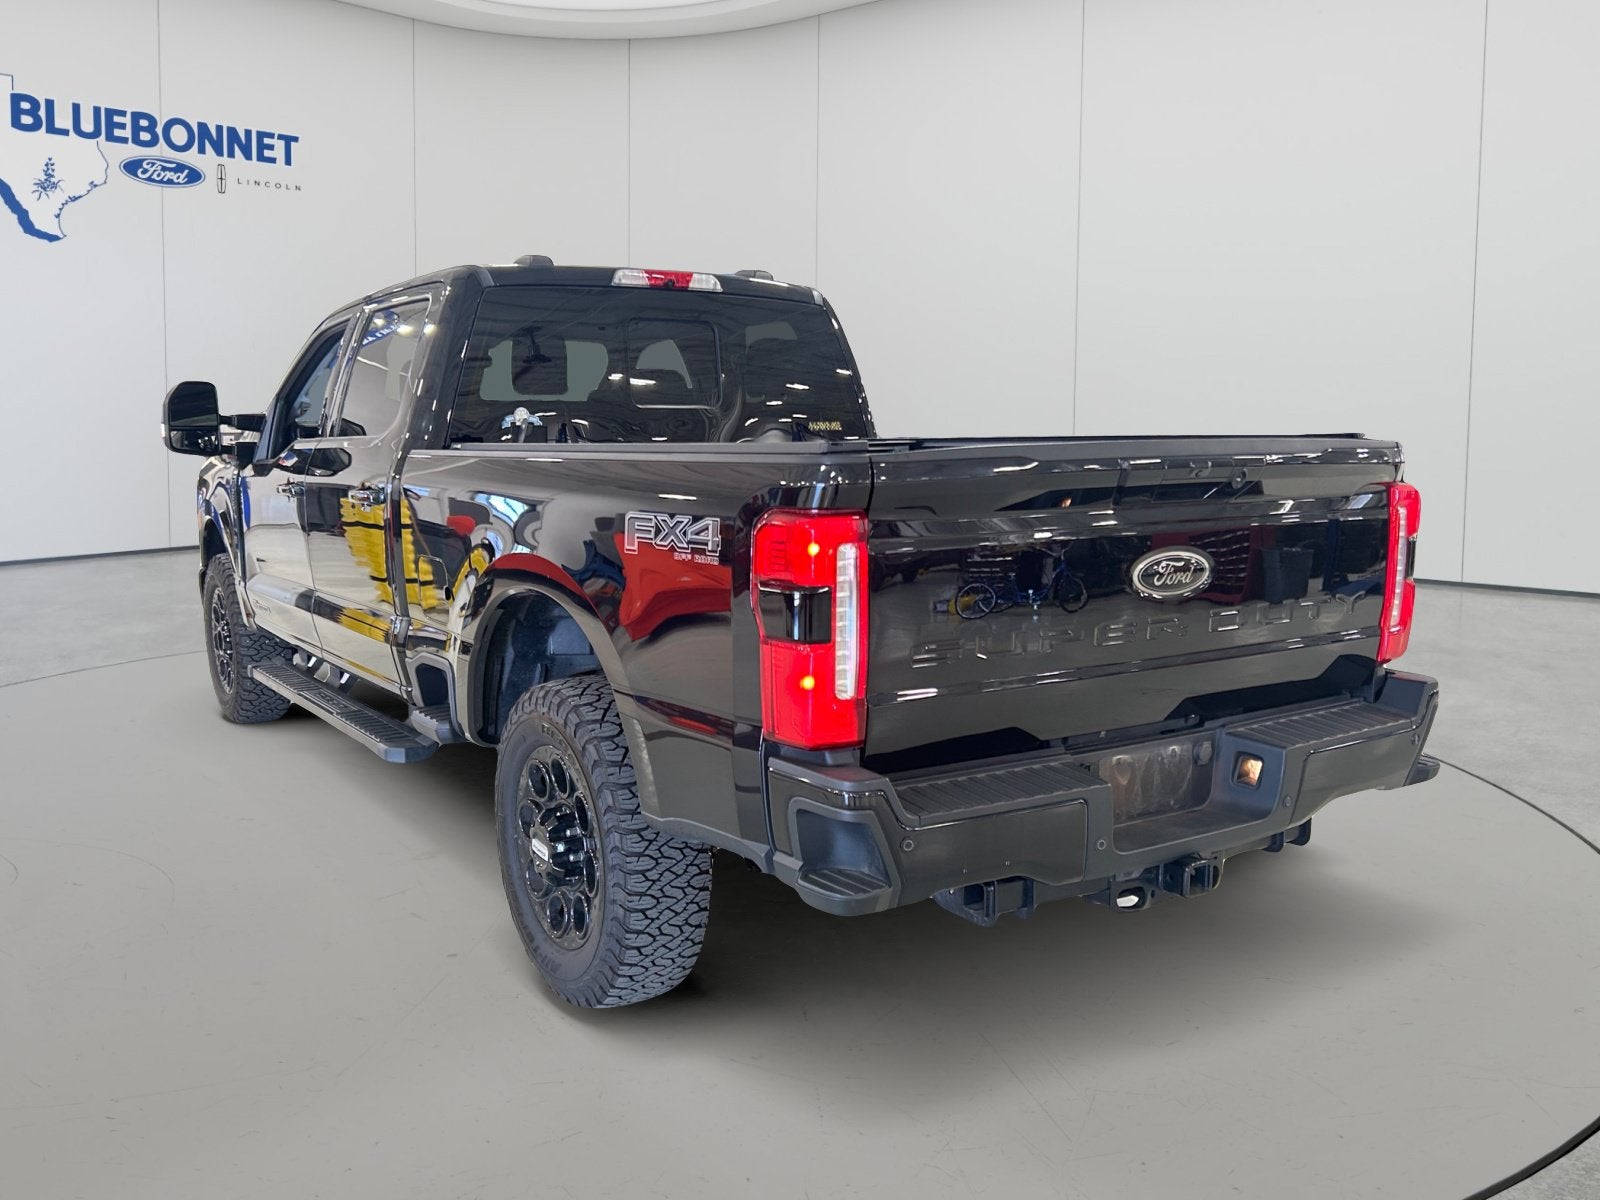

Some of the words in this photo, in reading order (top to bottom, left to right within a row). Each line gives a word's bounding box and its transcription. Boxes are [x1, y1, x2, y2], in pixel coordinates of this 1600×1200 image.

[10, 92, 299, 167] BLUEBONNET
[137, 158, 189, 185] Ford
[236, 177, 302, 192] LINCOLN
[624, 511, 721, 556] FX4
[1153, 560, 1194, 586] Ford
[910, 614, 1188, 669] SUPER
[1208, 590, 1368, 633] DUTY
